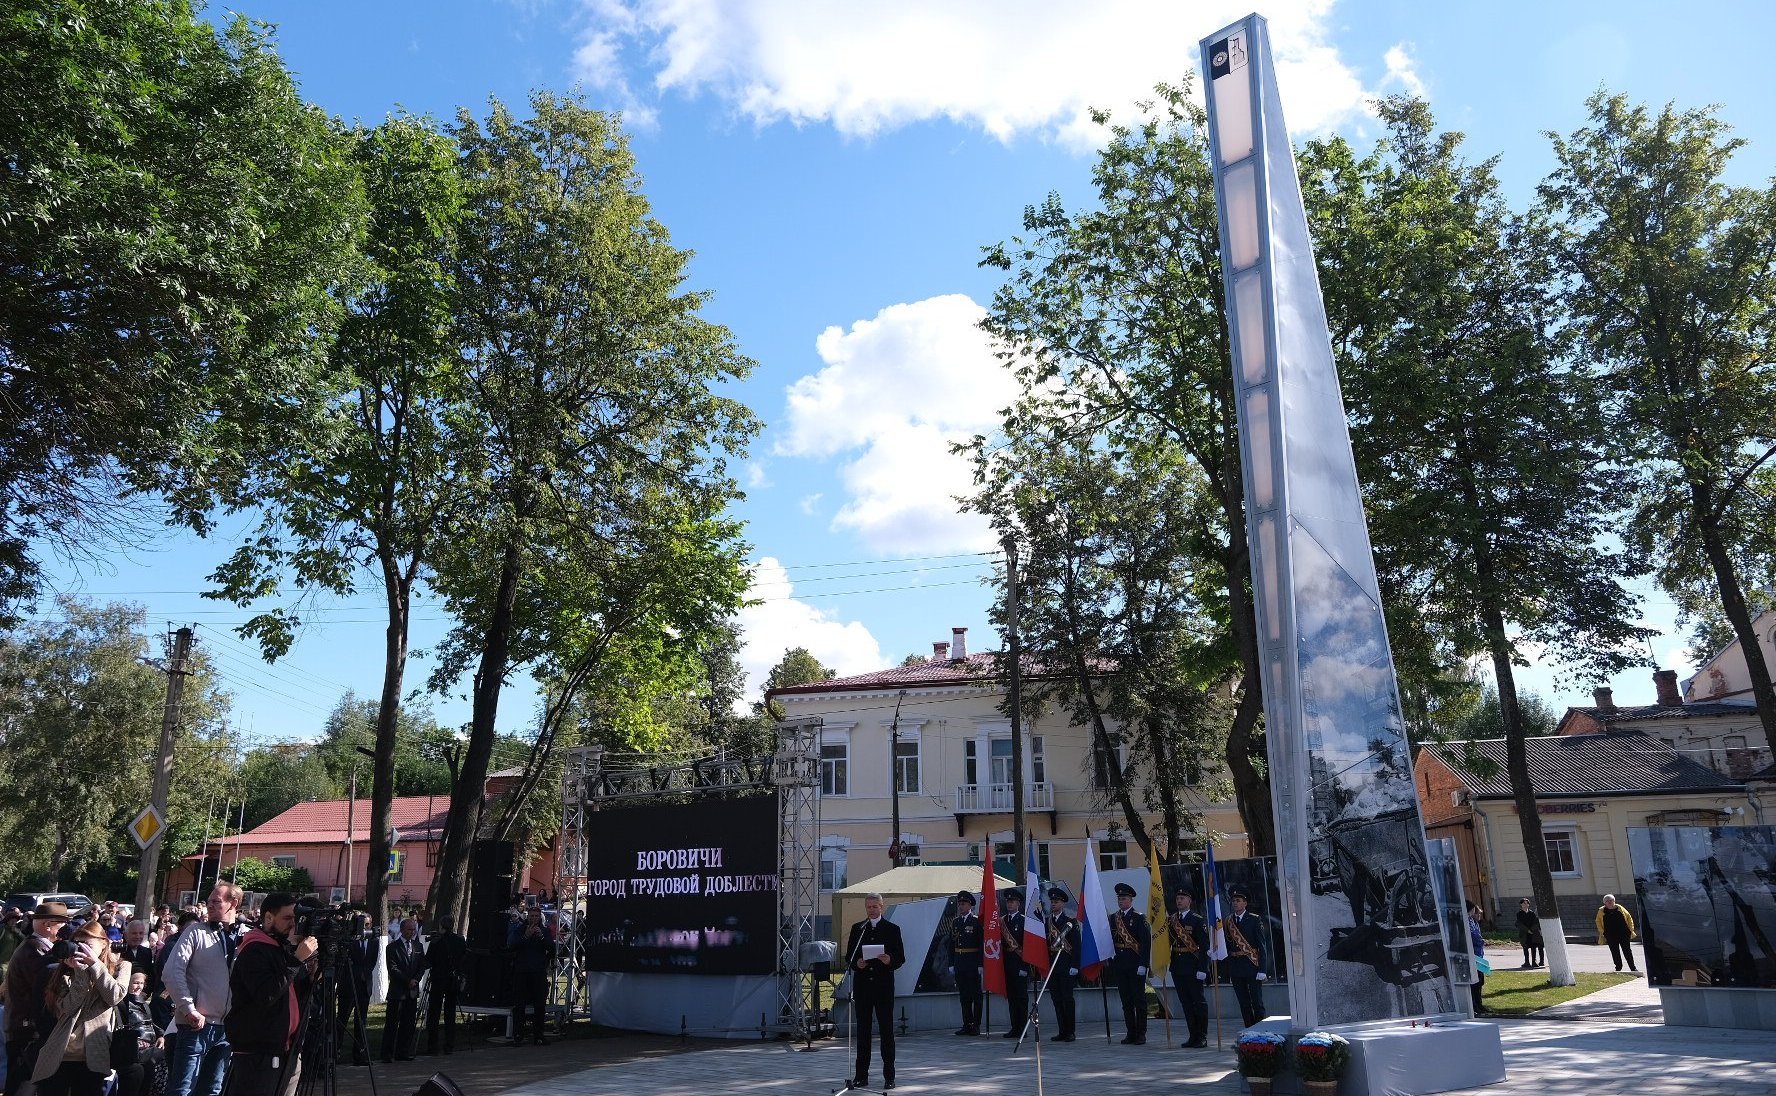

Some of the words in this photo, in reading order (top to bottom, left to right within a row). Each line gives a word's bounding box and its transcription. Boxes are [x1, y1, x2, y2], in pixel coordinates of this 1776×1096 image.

[637, 848, 722, 870] БОРОВИЧИ
[588, 880, 626, 898] ГОРОД
[631, 874, 700, 897] ТРУДОВОЙ
